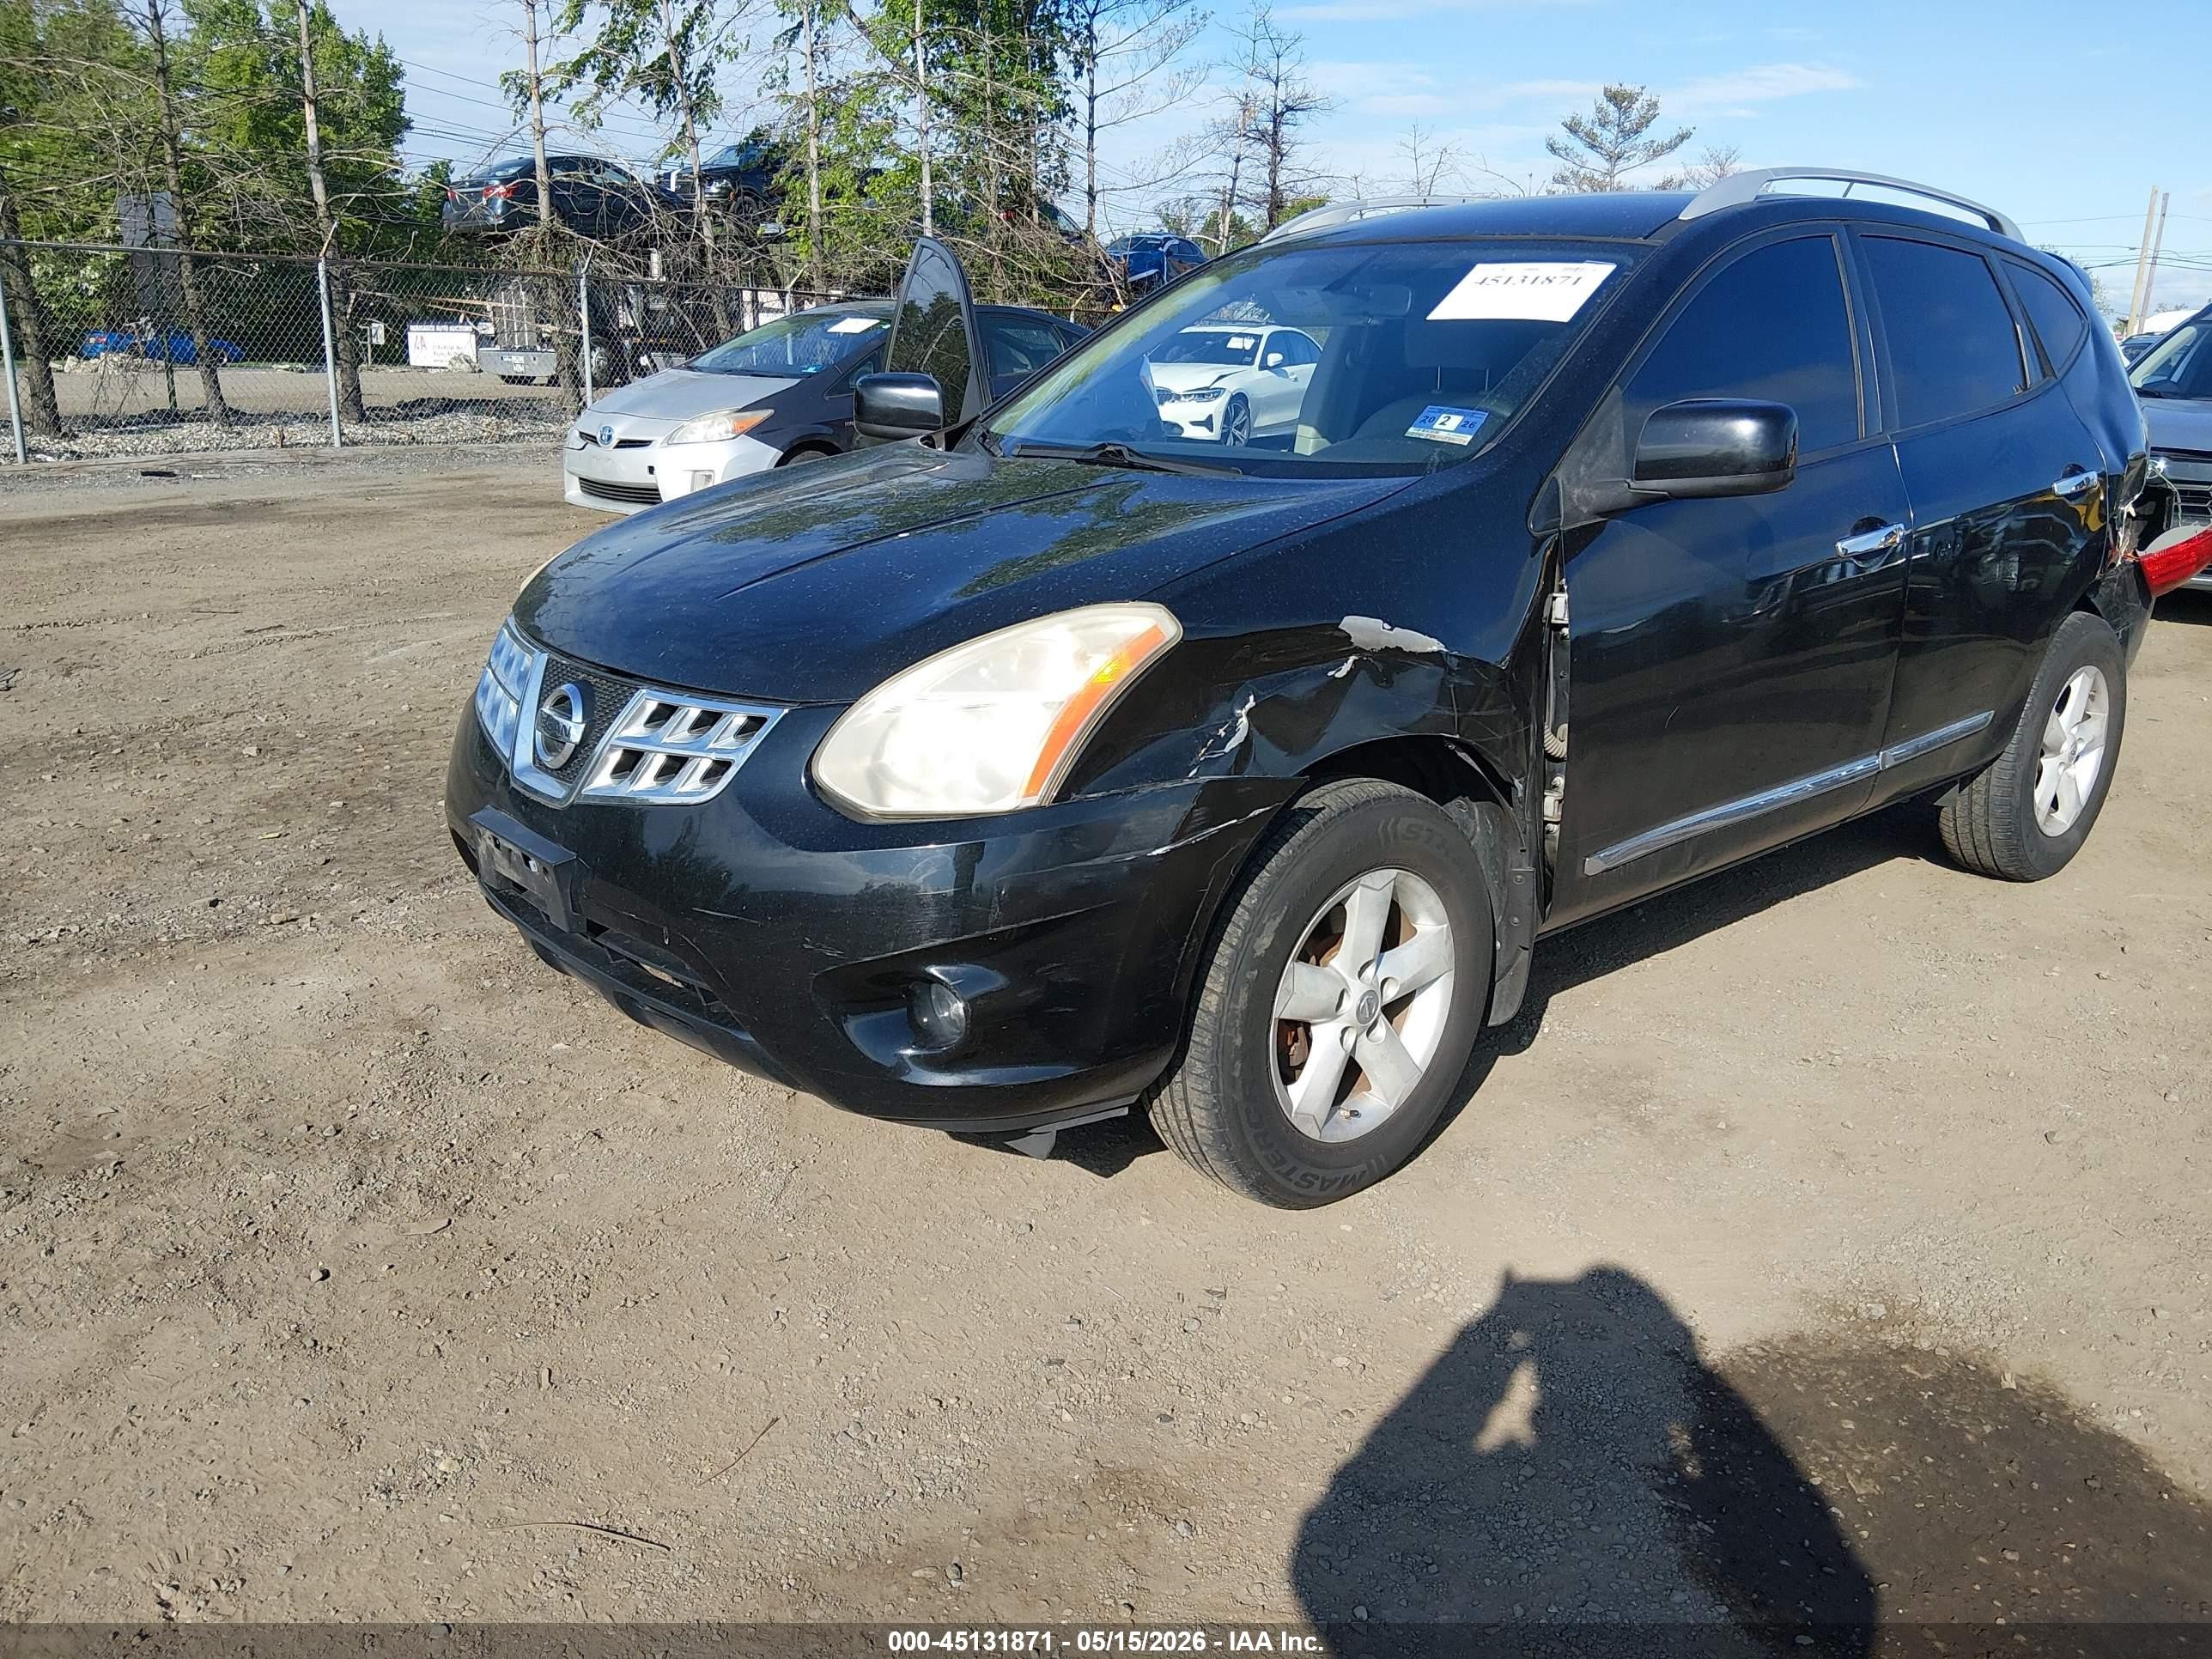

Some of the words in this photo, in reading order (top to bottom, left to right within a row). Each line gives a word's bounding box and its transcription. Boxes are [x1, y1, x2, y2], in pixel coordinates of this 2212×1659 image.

[1474, 275, 1583, 286] 45131871
[1419, 416, 1437, 425] 20
[1438, 416, 1451, 426] 2
[1461, 420, 1478, 429] 26
